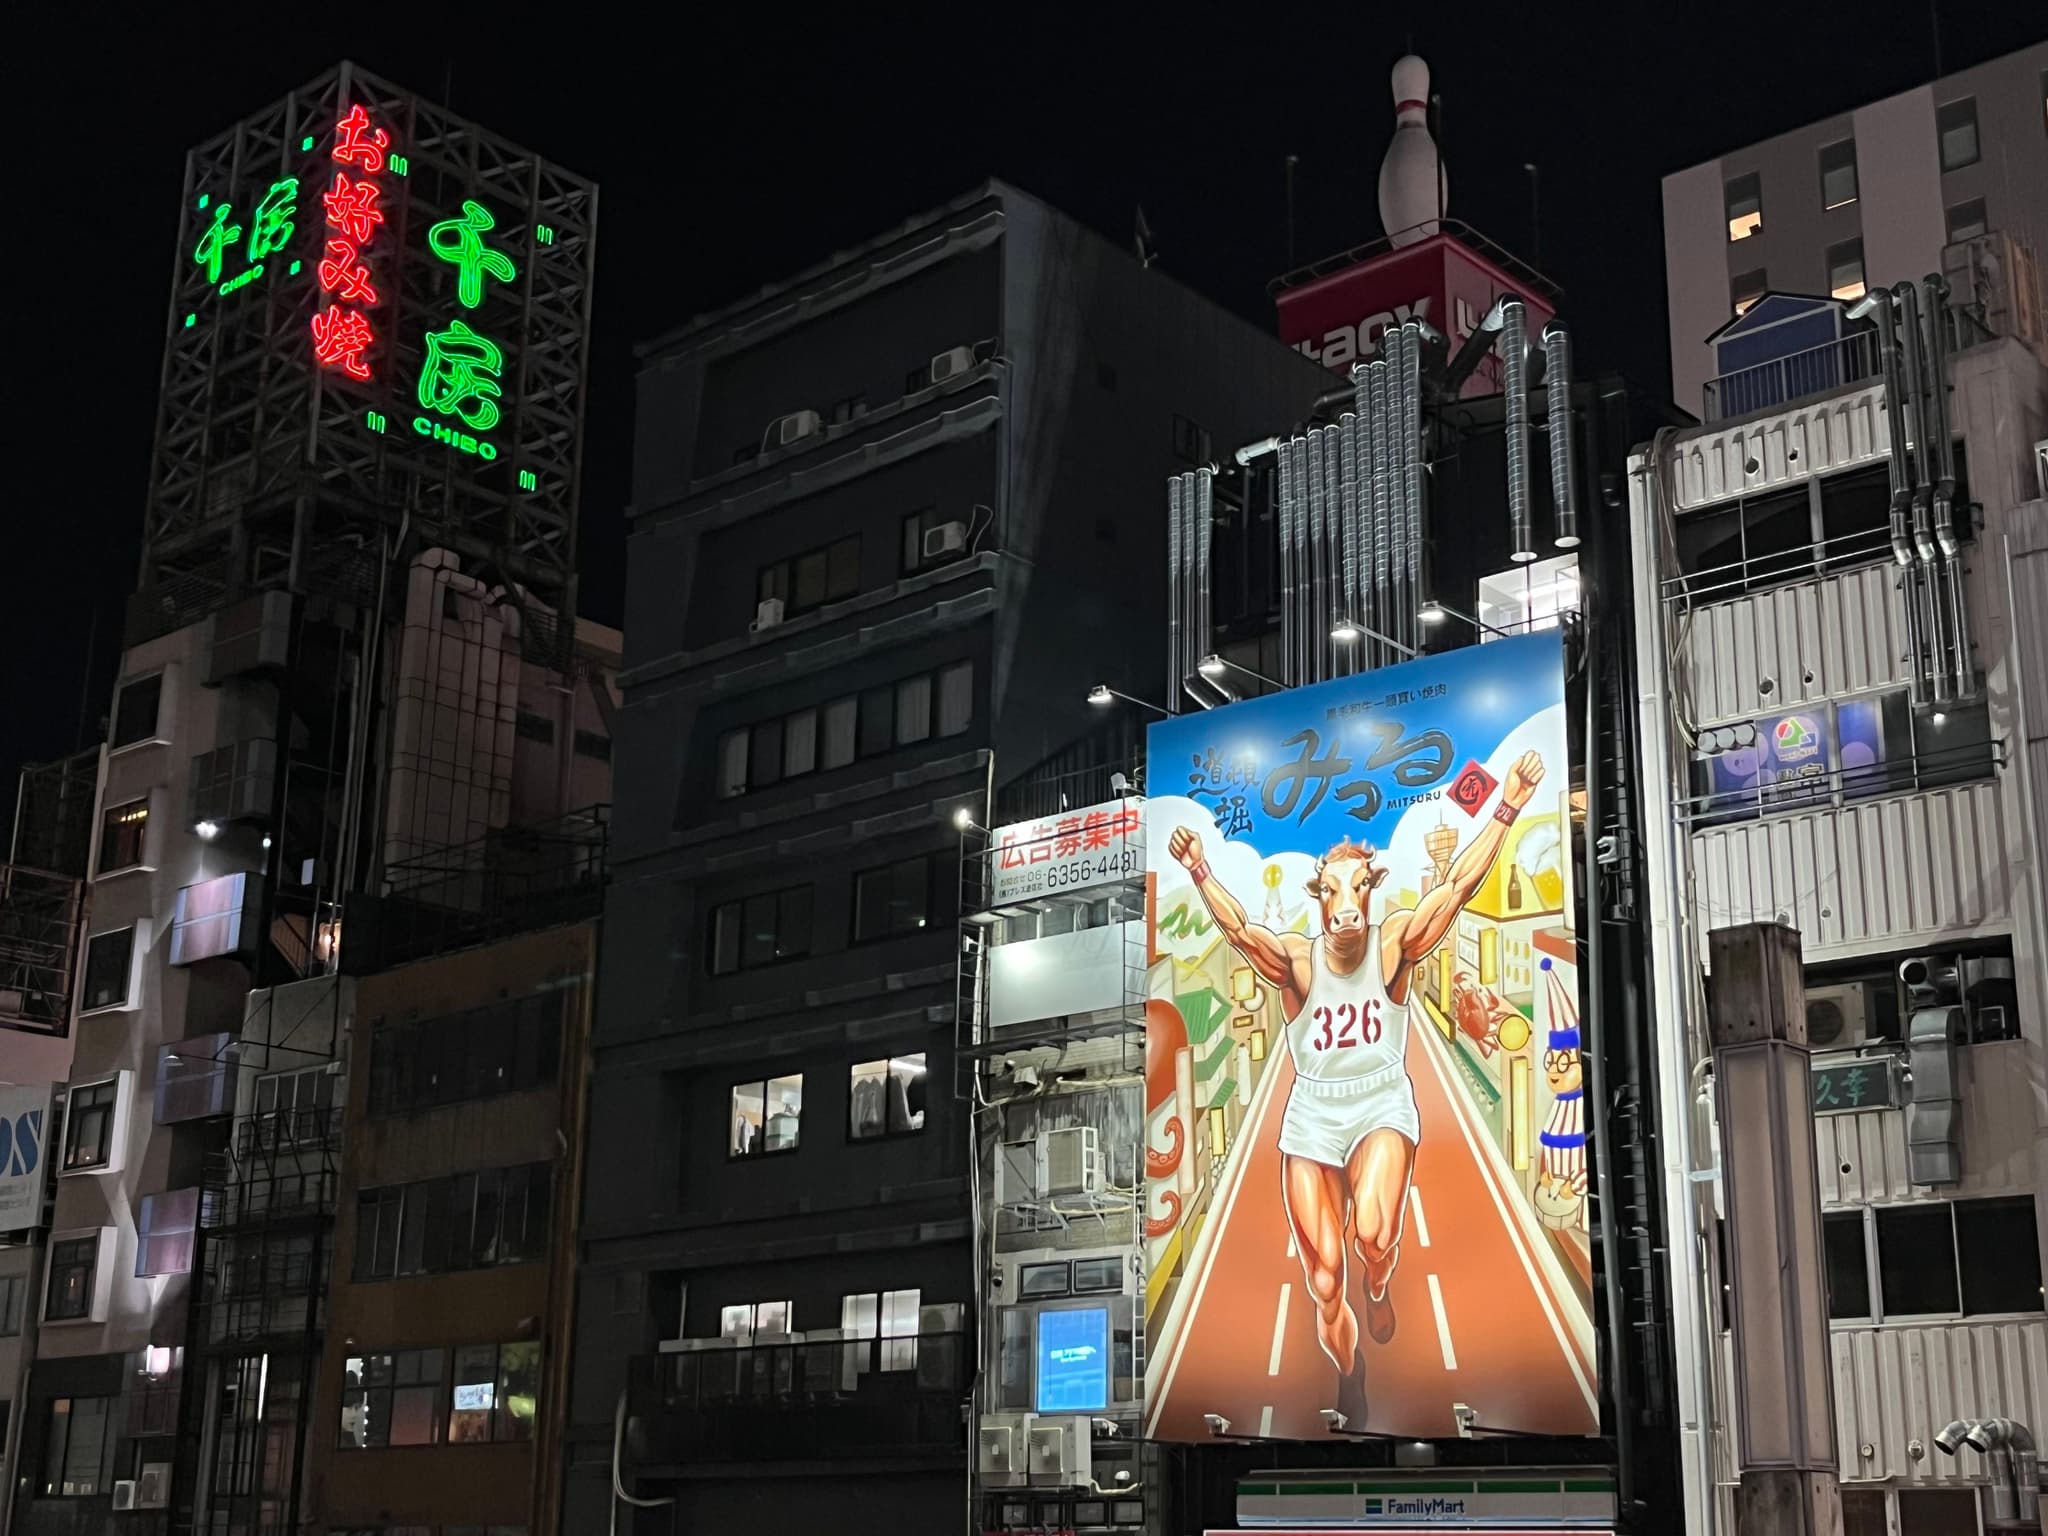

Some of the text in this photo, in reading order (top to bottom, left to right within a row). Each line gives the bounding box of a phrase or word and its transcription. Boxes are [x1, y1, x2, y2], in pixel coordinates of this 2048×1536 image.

[218, 264, 264, 296] CHIBO
[412, 415, 498, 461] CHIBO
[1386, 790, 1442, 810] MITSURU
[1000, 803, 1139, 870] 広告募集中
[1313, 998, 1382, 1051] 326
[1388, 1497, 1465, 1516] FamilyMart
